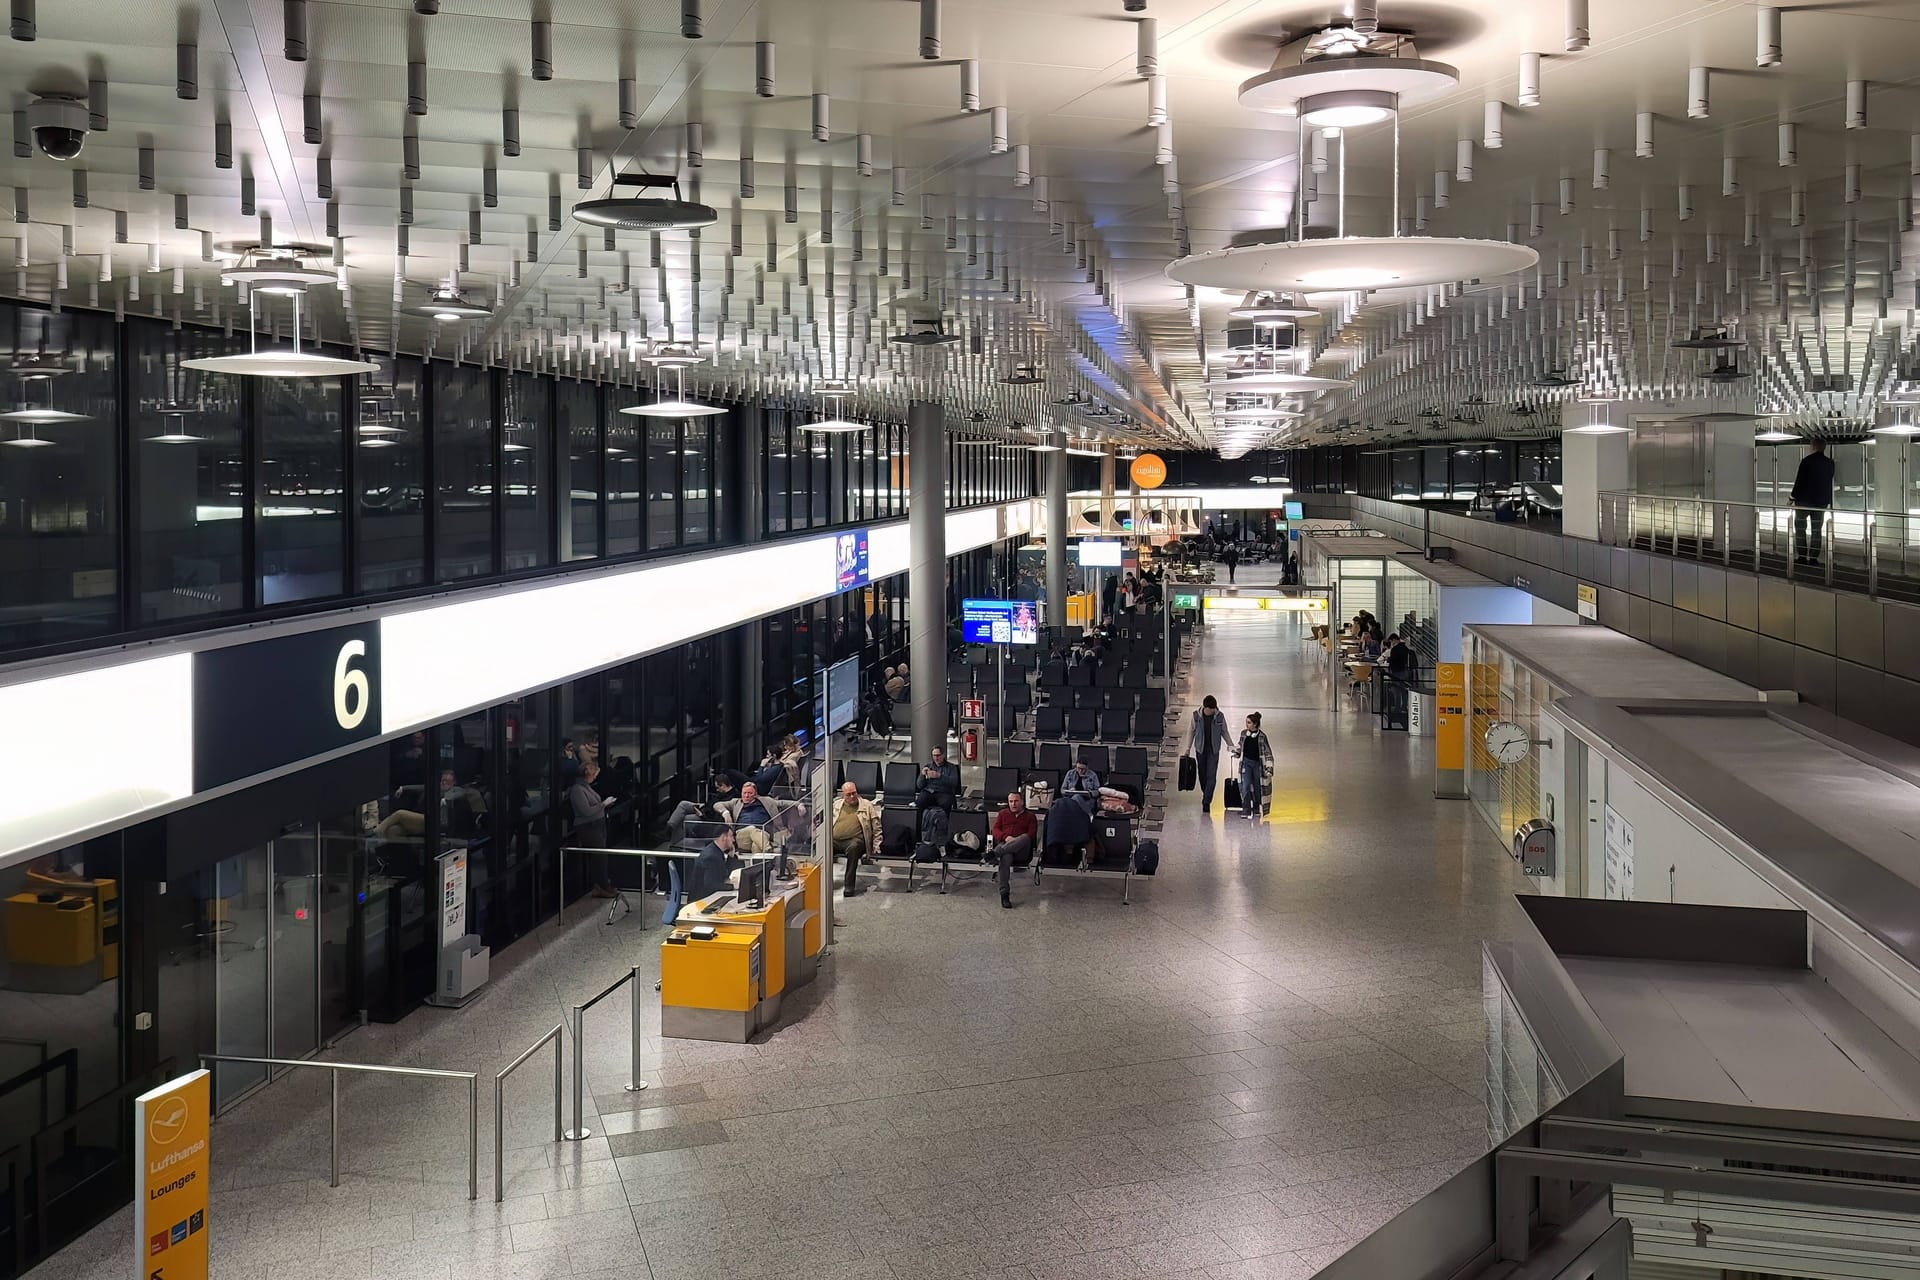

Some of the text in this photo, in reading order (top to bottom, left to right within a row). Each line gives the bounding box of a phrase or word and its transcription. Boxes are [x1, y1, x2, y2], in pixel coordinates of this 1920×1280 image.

[334, 639, 369, 730] 6
[151, 1139, 205, 1174] Lufthansa
[151, 1170, 196, 1200] Lounges
